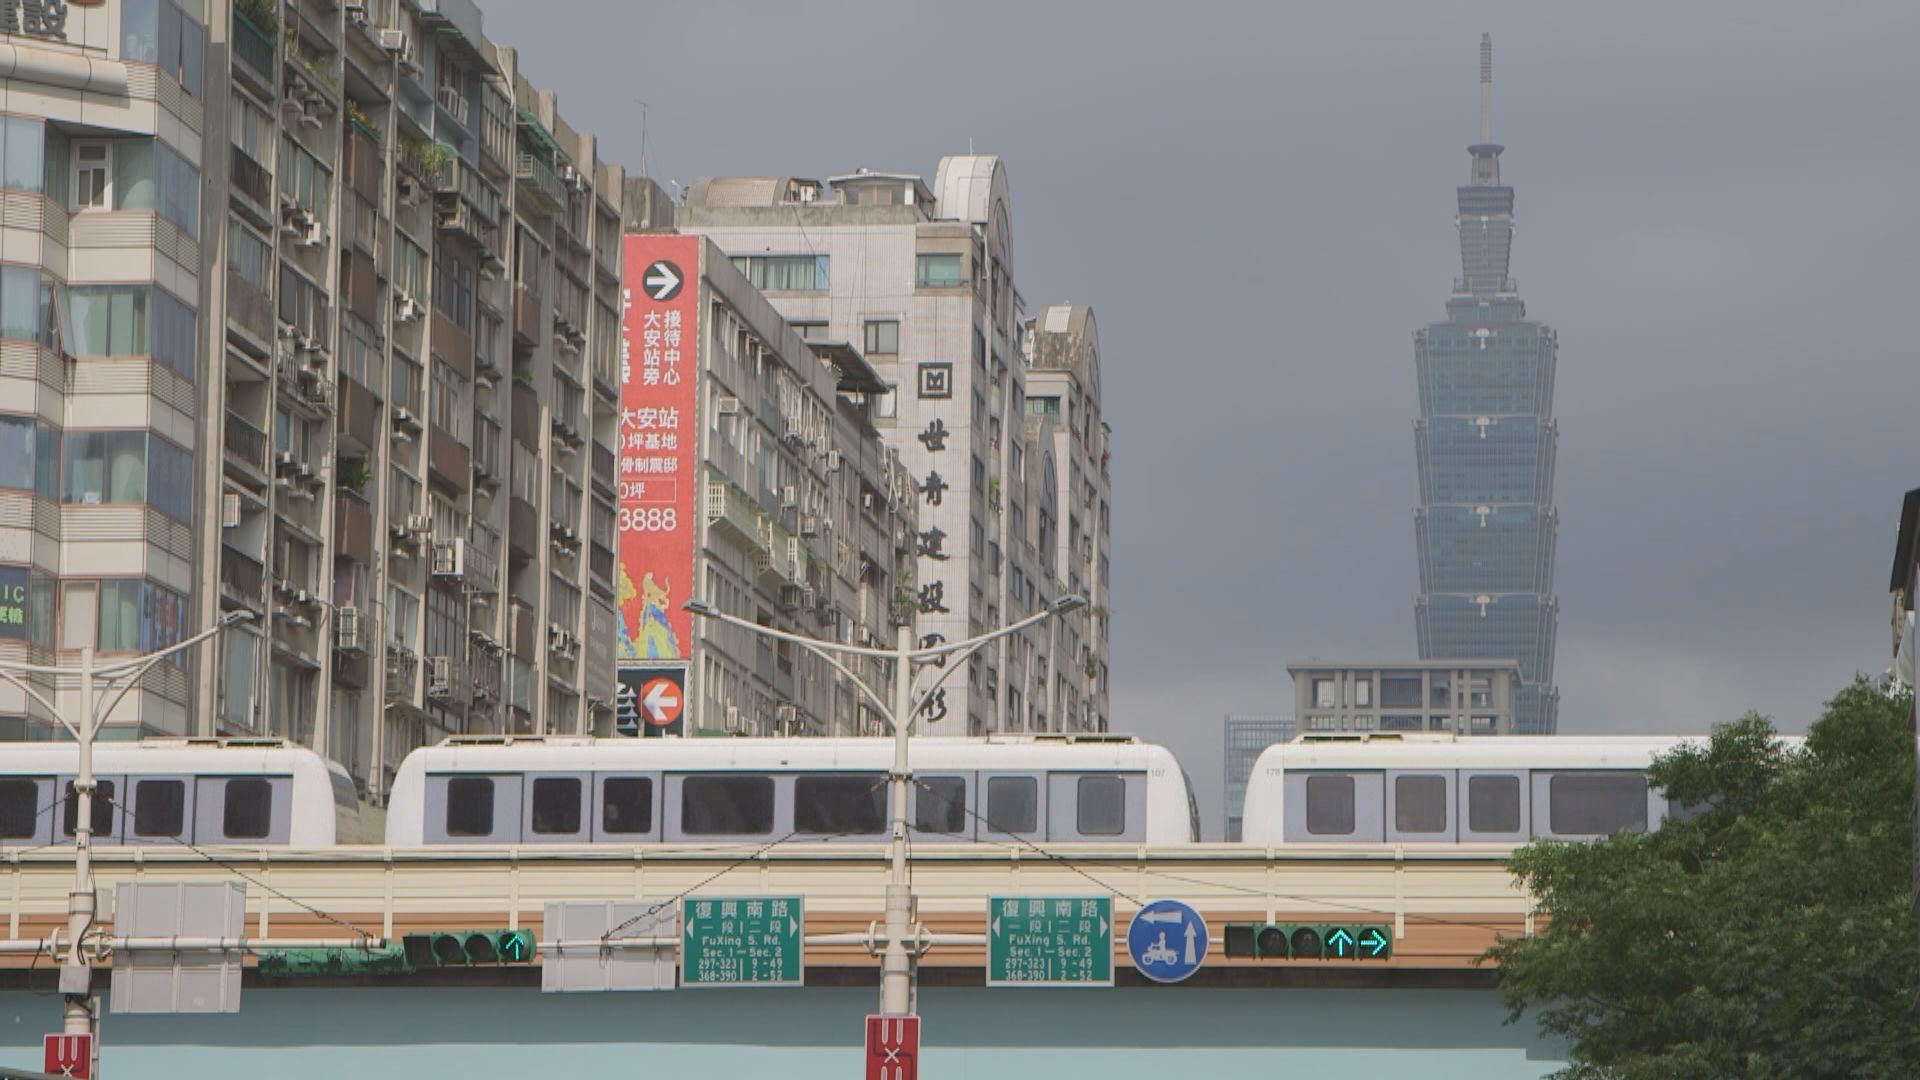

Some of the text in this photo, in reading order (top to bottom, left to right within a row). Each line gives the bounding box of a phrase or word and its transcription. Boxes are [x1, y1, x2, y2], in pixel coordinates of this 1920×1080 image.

[643, 309, 661, 385] 大安站旁
[664, 309, 681, 386] 接待中心
[620, 406, 679, 430] 大安站
[696, 900, 788, 919] 復興南路
[1002, 900, 1098, 917] 復興南路
